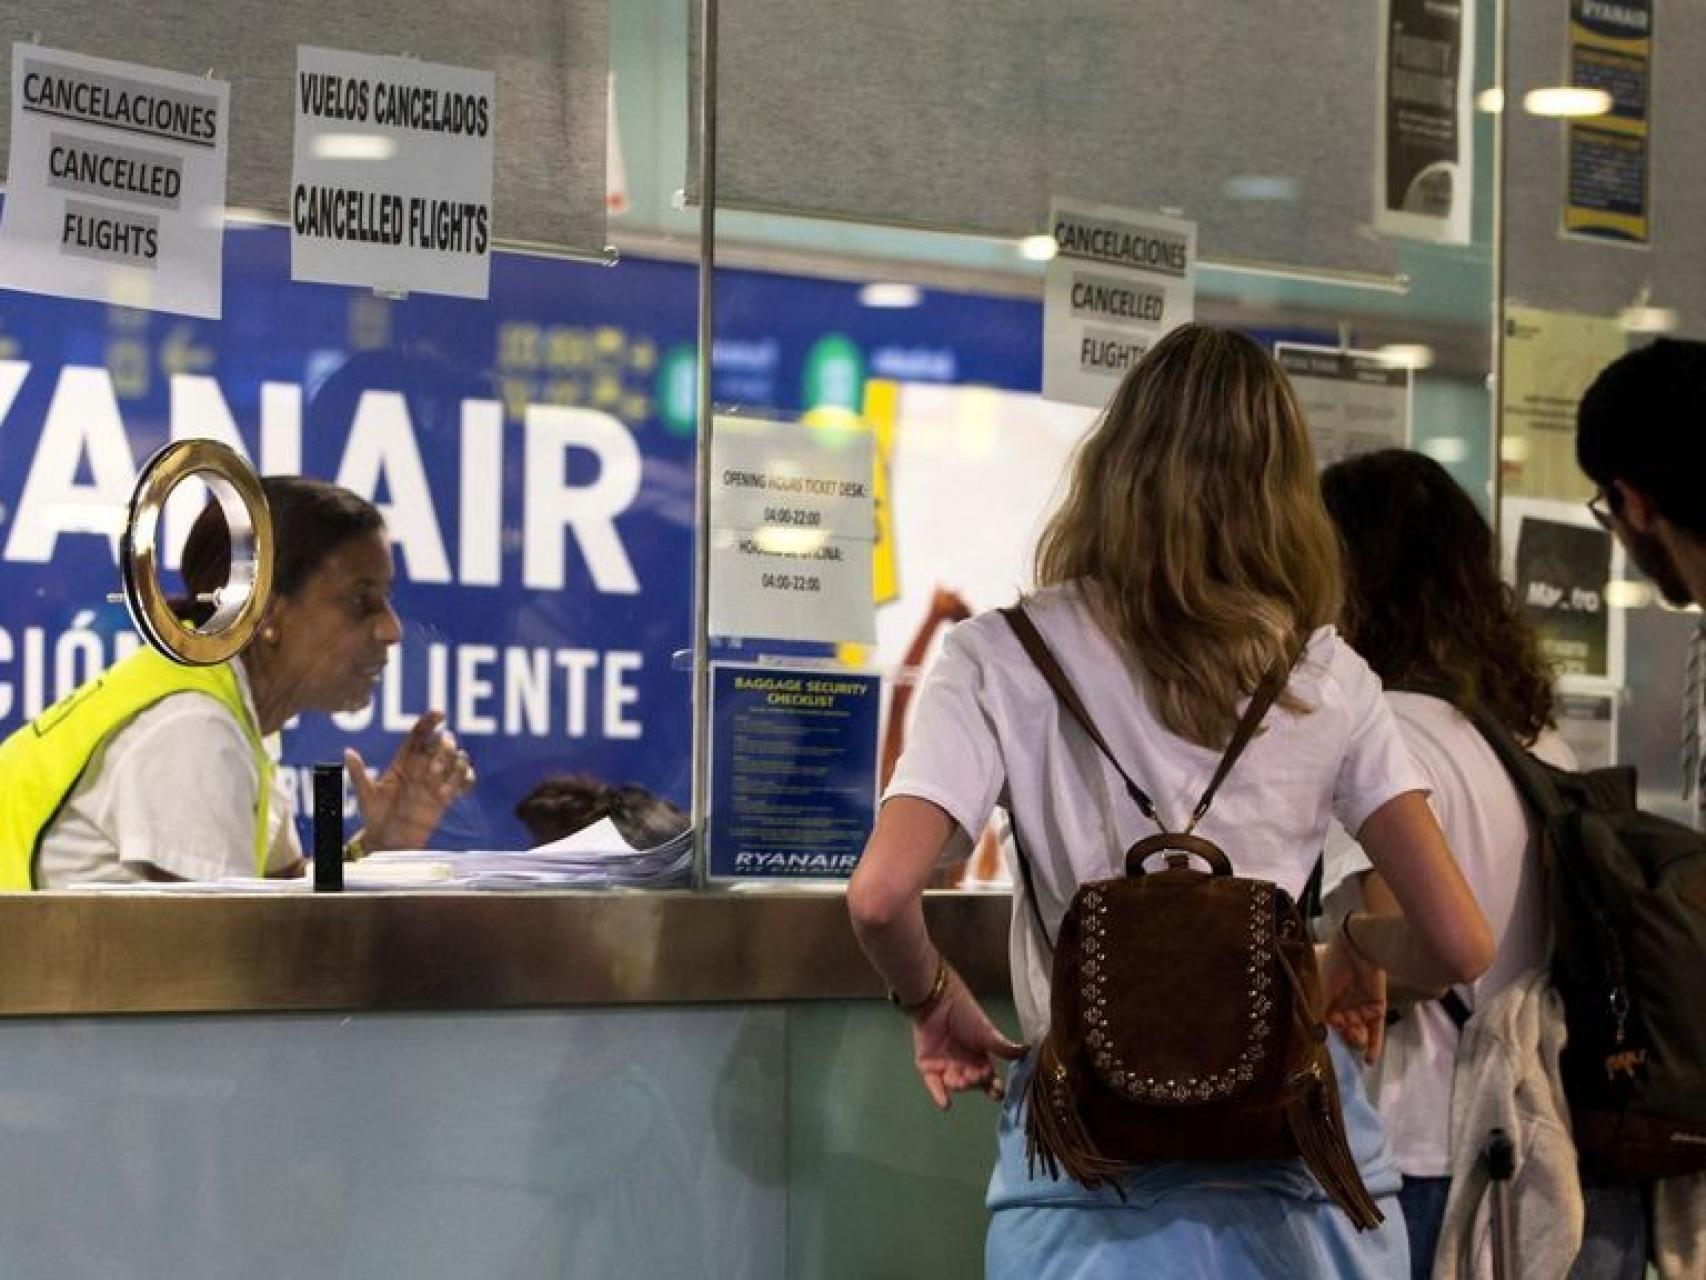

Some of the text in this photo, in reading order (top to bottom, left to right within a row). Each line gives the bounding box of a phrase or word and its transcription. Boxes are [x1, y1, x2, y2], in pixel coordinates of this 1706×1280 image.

[23, 72, 217, 139] CANCELACIONES
[300, 71, 489, 137] VUELOS CANCELADOS
[49, 145, 181, 198] CANCELLED
[62, 212, 158, 259] FLIGHTS
[294, 184, 488, 255] CANCELLED FLIGHTS
[1054, 221, 1186, 270] CANCELACIONES
[1071, 281, 1164, 322] CANCELLED
[723, 470, 765, 489] OPENING
[735, 677, 868, 697] BAGGAGE SECURITY
[766, 693, 834, 708] CHECKLIST
[735, 851, 858, 868] RYANAIR
